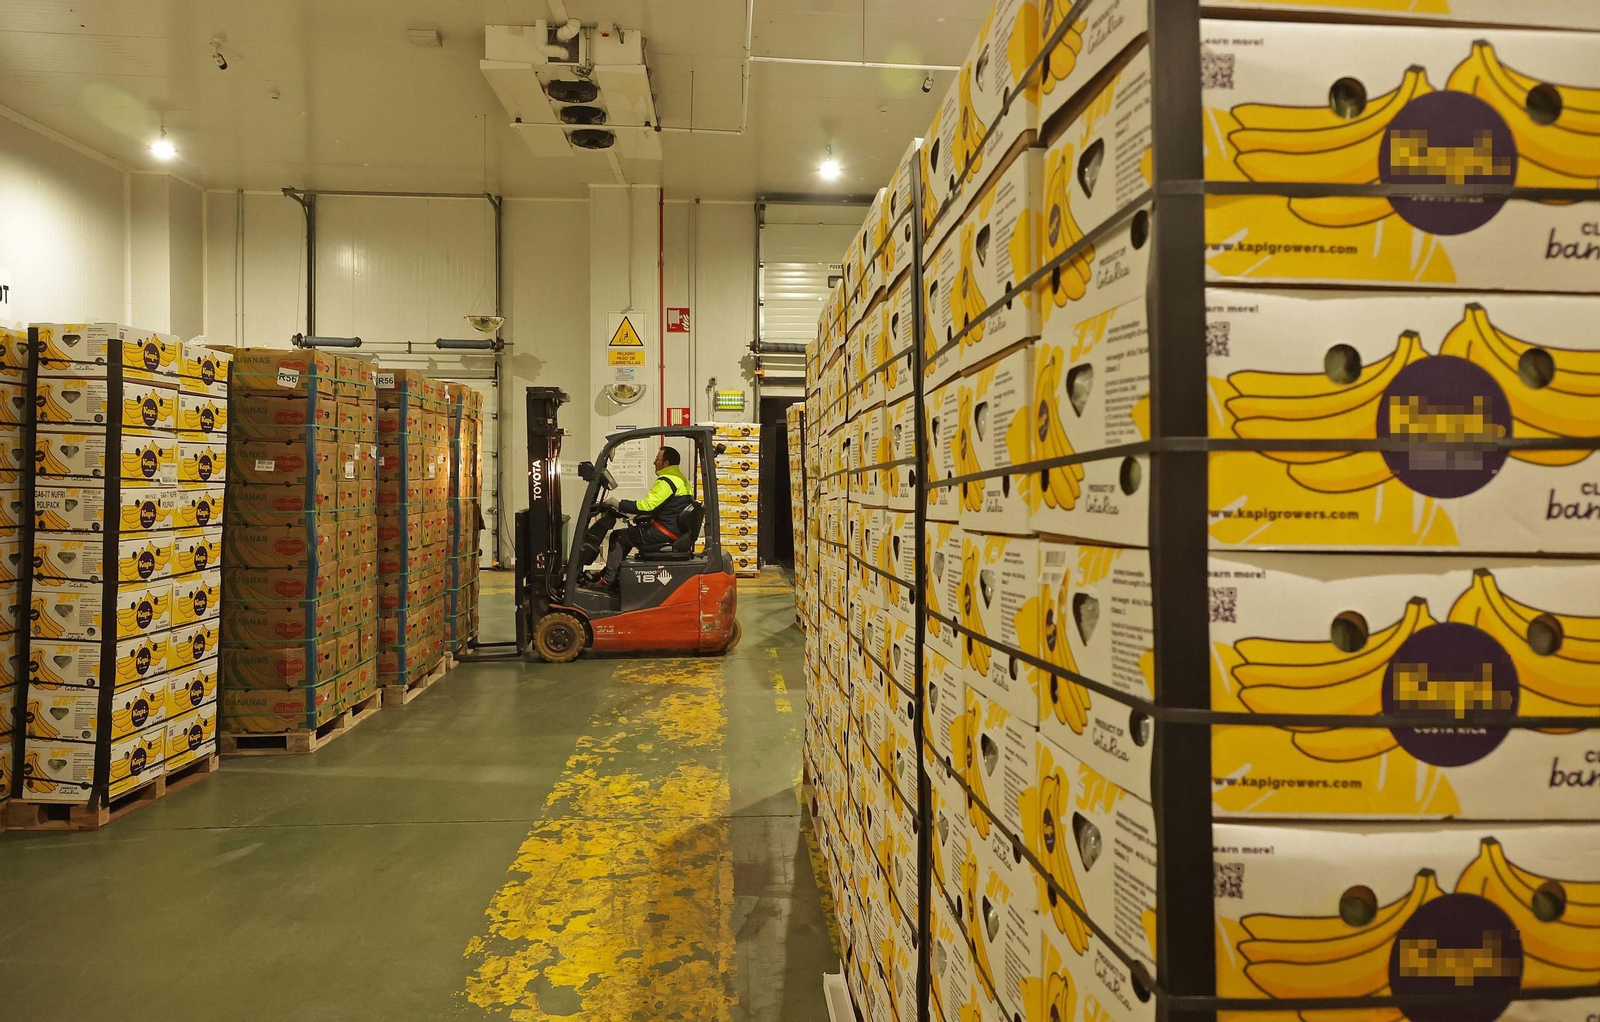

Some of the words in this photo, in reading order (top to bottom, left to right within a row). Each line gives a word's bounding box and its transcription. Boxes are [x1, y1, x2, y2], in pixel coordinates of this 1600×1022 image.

[533, 460, 541, 500] TOYOTA
[1208, 508, 1359, 521] ww.kapigrowers.com
[1234, 570, 1266, 578] more!
[1242, 846, 1275, 854] more!
